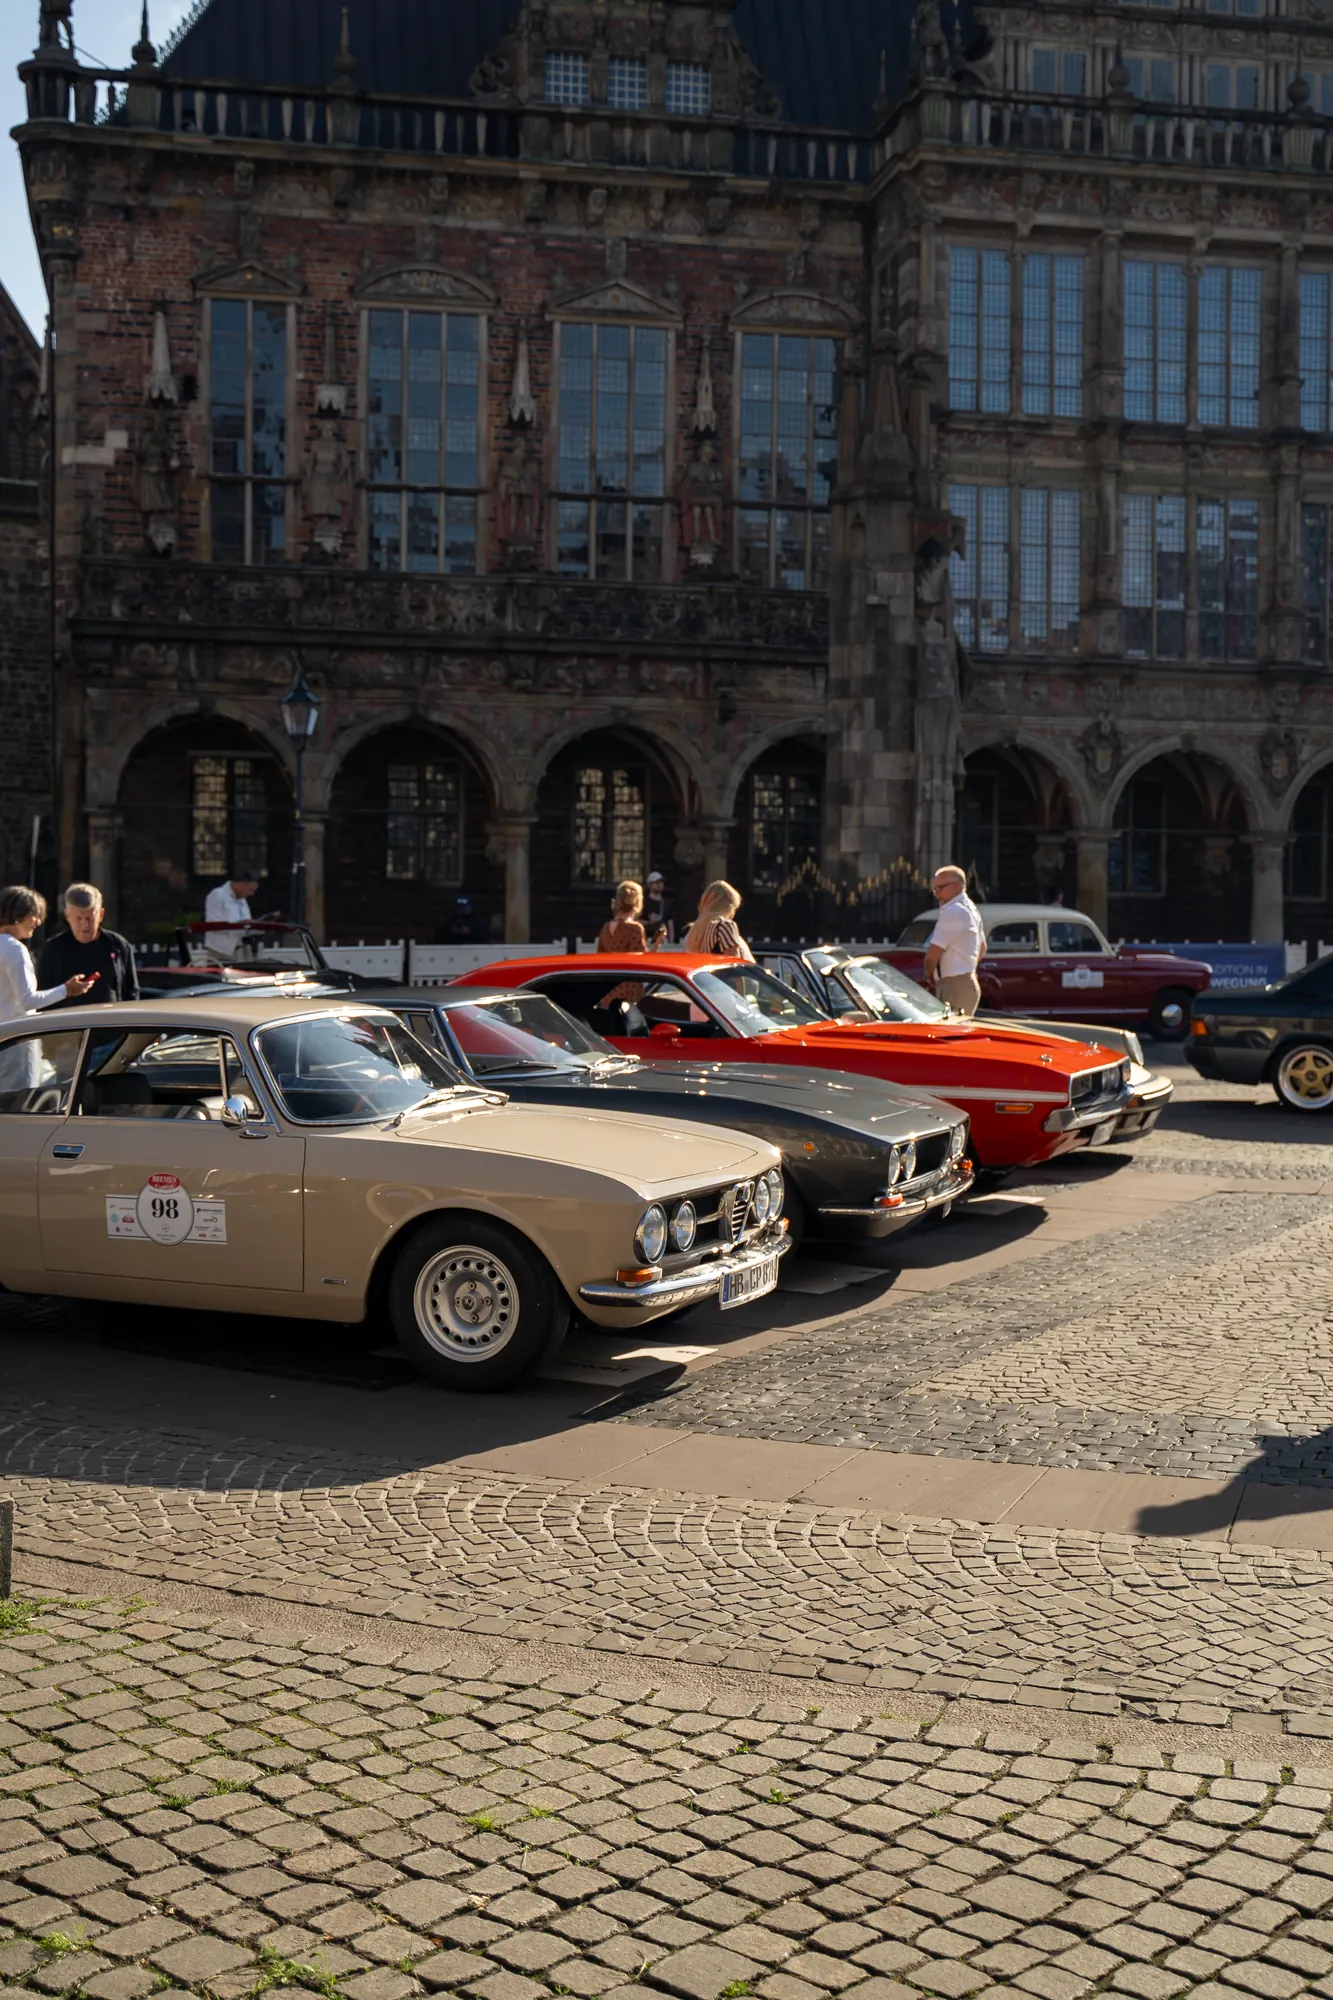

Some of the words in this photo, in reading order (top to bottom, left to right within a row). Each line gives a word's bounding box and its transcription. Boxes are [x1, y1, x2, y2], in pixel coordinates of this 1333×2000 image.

[152, 1175, 177, 1183] BREMEN
[151, 1197, 179, 1219] 98
[729, 1272, 744, 1299] HB
[749, 1265, 762, 1290] CP
